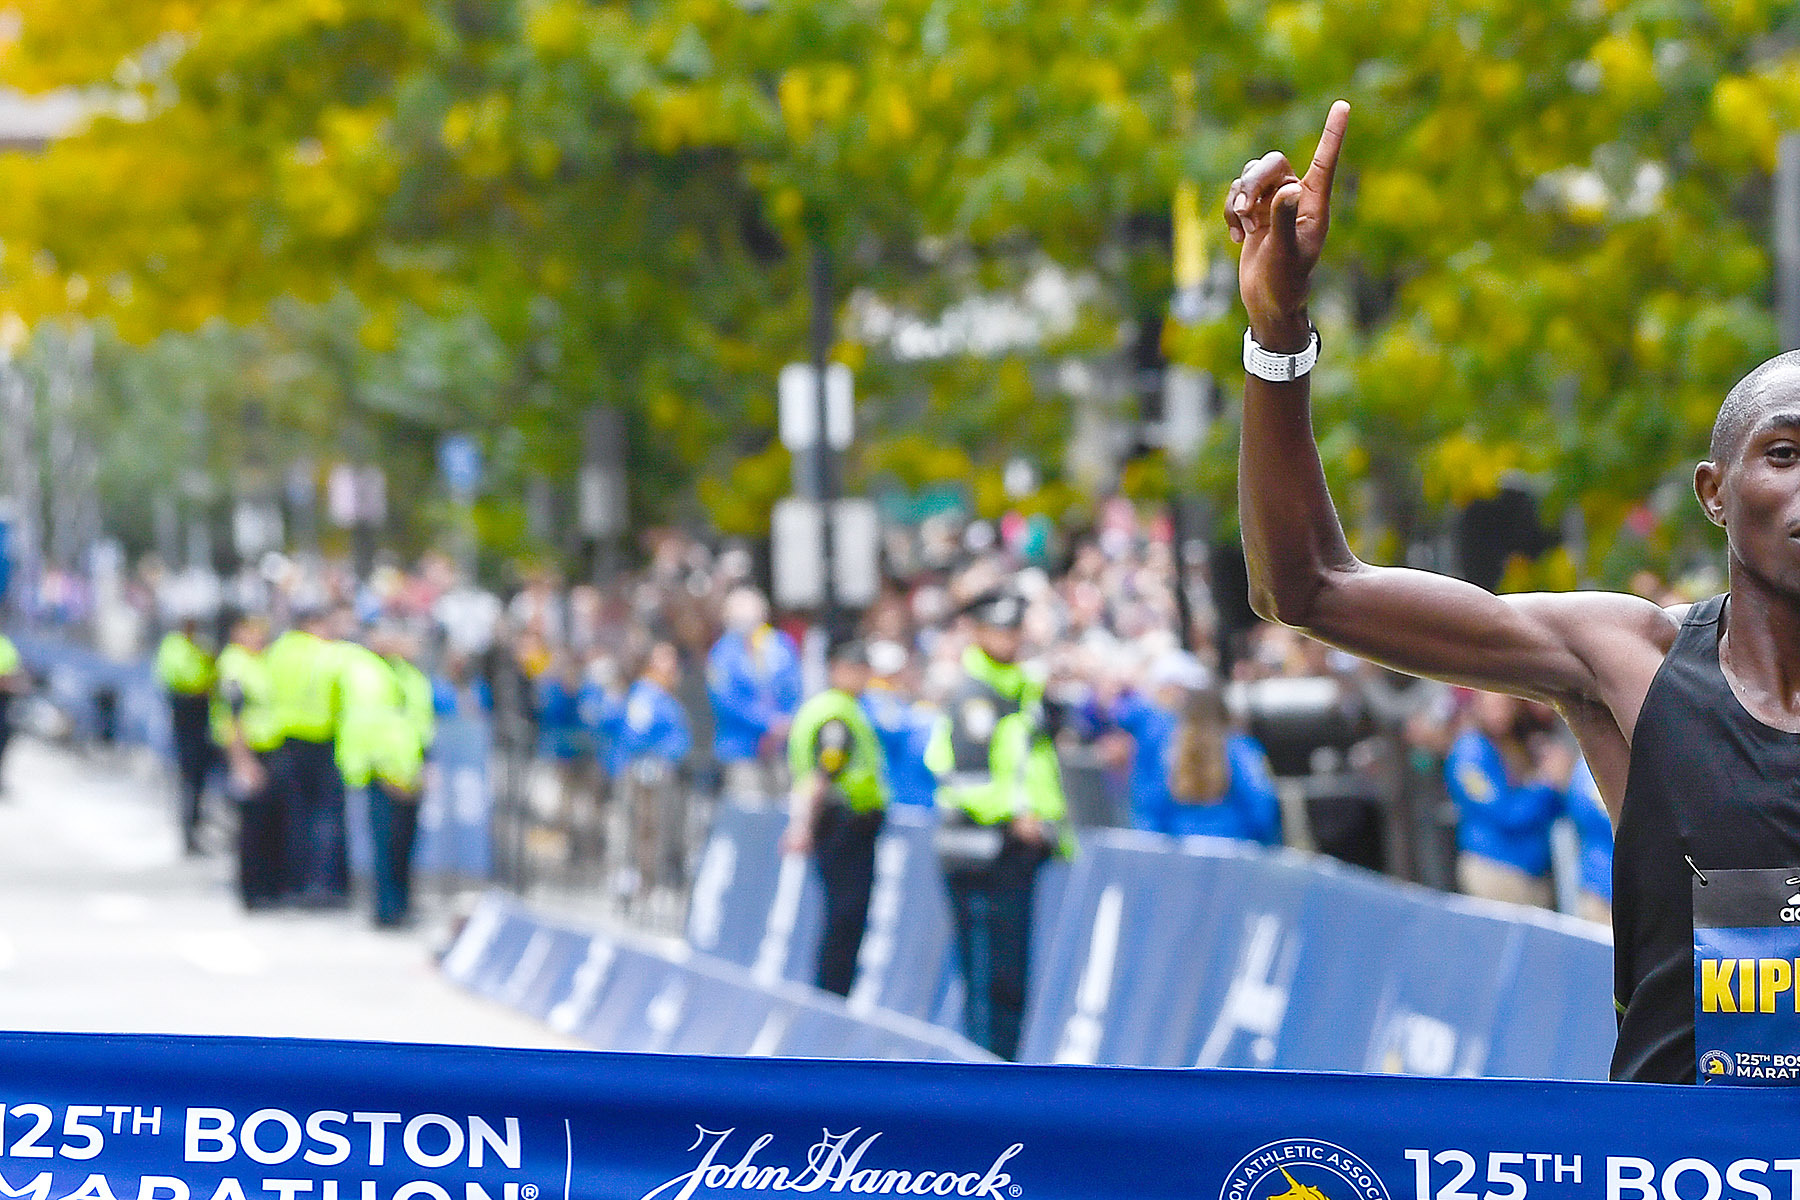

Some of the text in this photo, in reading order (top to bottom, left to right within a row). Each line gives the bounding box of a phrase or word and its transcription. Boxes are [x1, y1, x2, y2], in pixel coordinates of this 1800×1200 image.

[1735, 1053, 1770, 1065] 125TH
[184, 1107, 521, 1169] BOSTON
[1244, 1145, 1325, 1180] ATHLETIC
